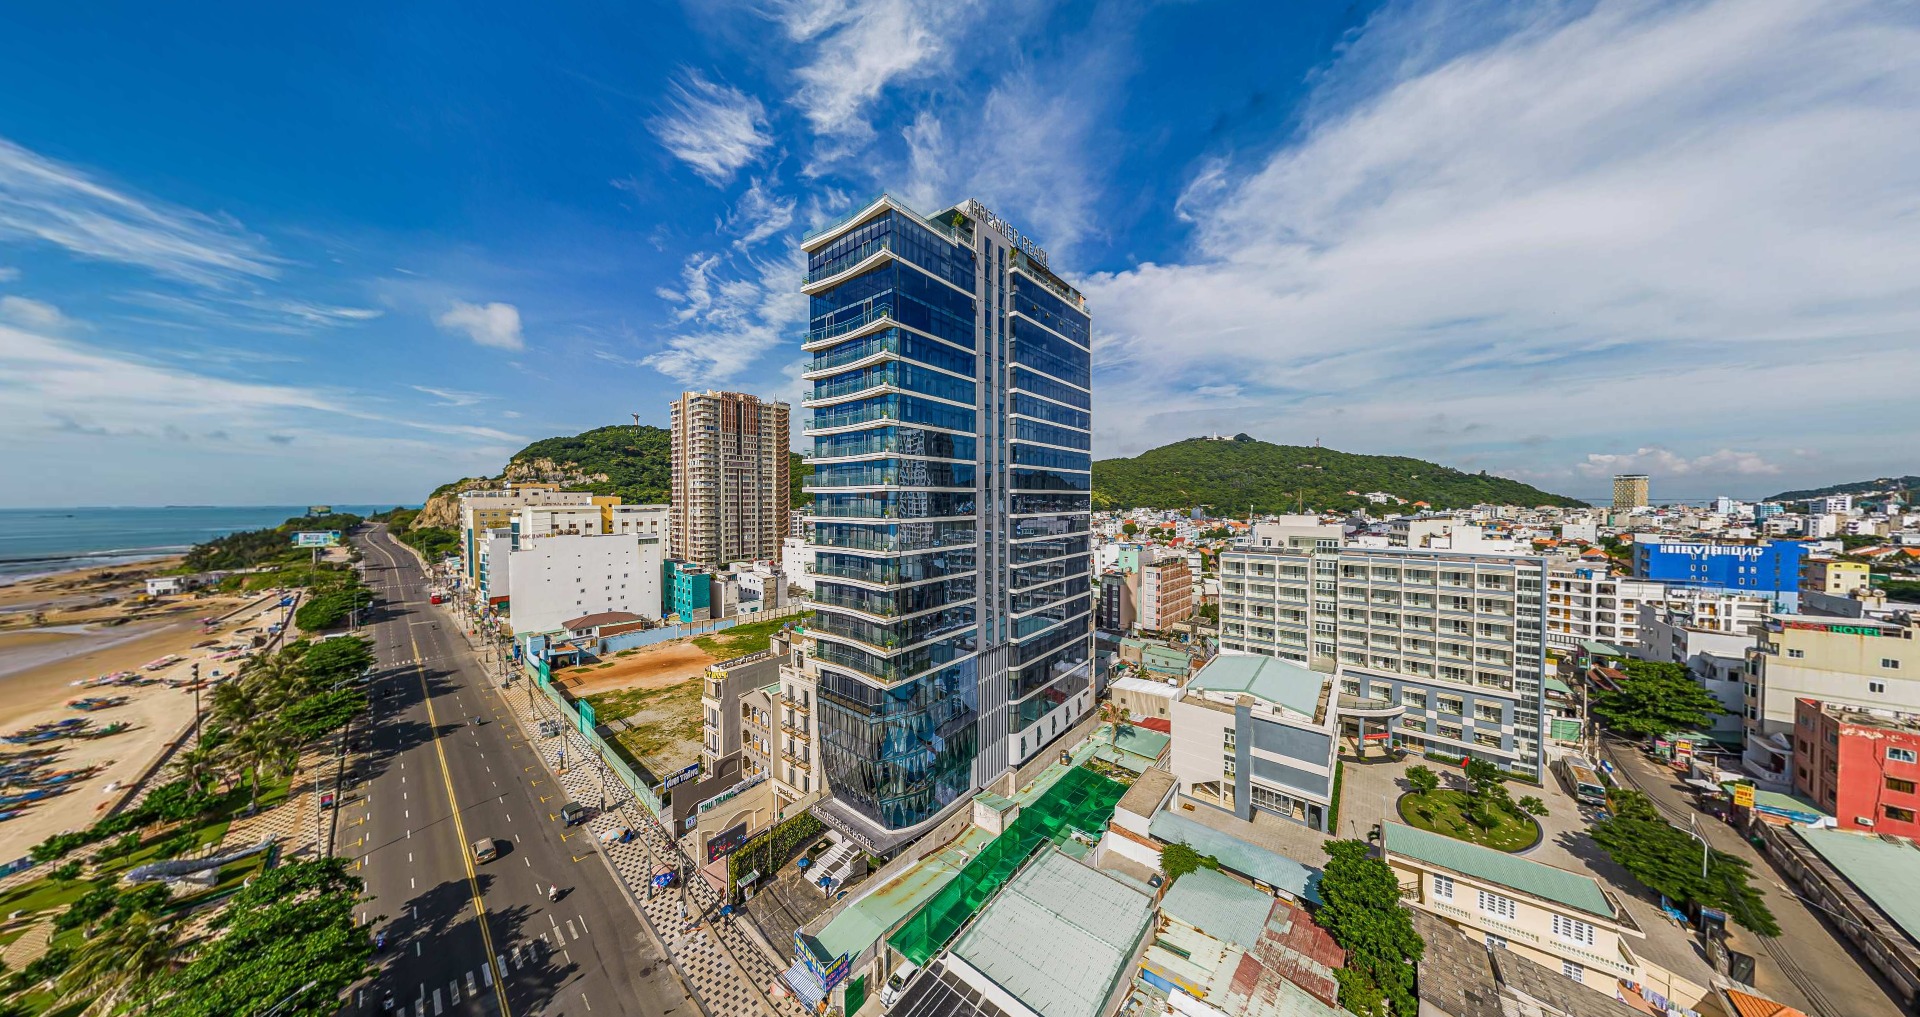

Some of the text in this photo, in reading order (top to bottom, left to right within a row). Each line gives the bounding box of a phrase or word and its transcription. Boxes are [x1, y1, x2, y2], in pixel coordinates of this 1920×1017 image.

[972, 198, 1050, 269] PREMIER PEARL
[1831, 624, 1881, 637] HOTEL
[700, 790, 734, 812] THU TRANG
